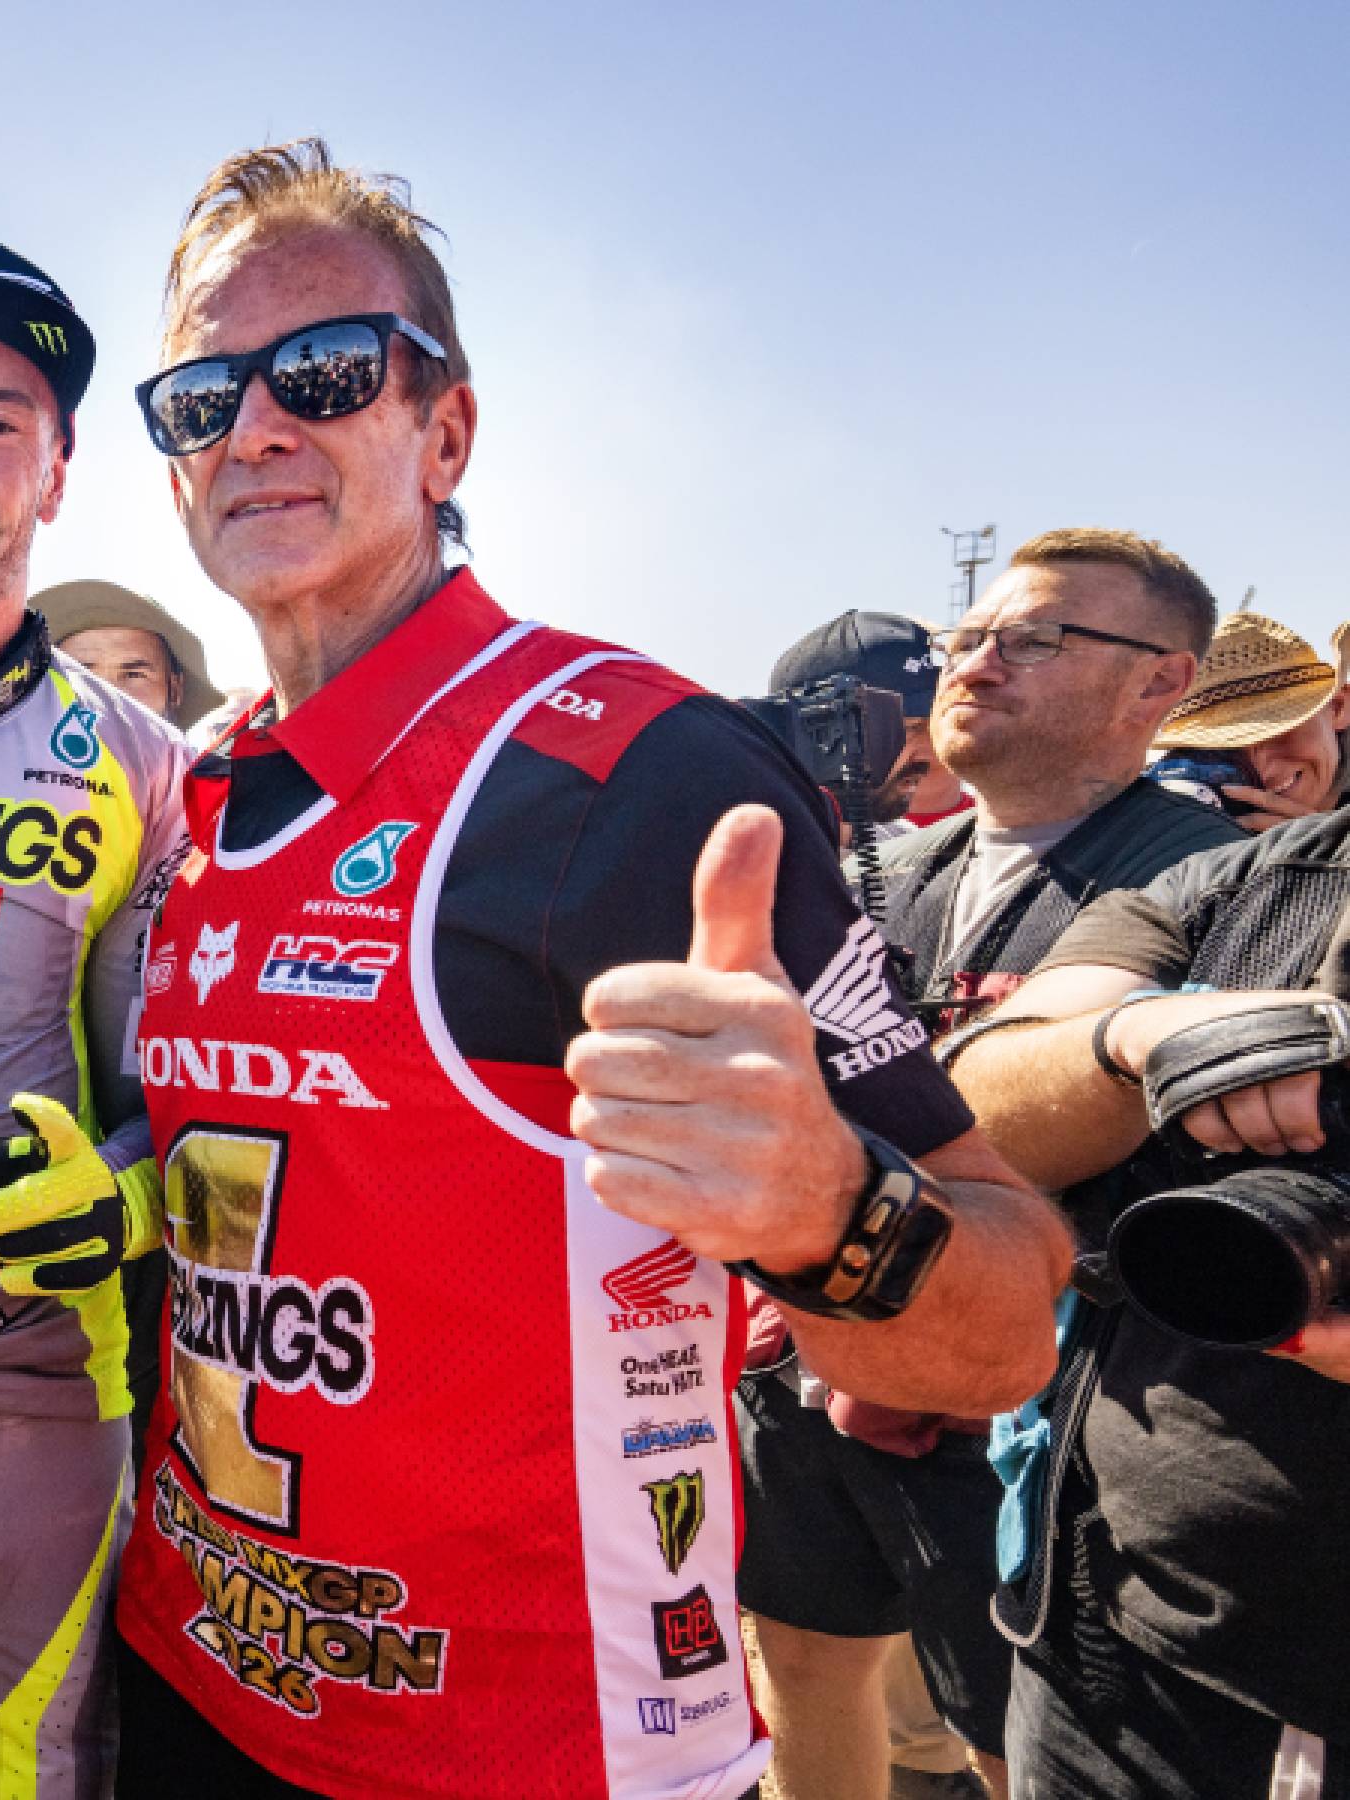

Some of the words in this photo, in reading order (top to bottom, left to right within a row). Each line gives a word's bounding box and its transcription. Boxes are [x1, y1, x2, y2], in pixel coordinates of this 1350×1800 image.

[546, 689, 605, 721] DA
[302, 900, 401, 922] PETRONAS
[259, 934, 400, 986] HRC
[828, 1018, 929, 1081] HOND
[606, 1302, 714, 1333] HONDA
